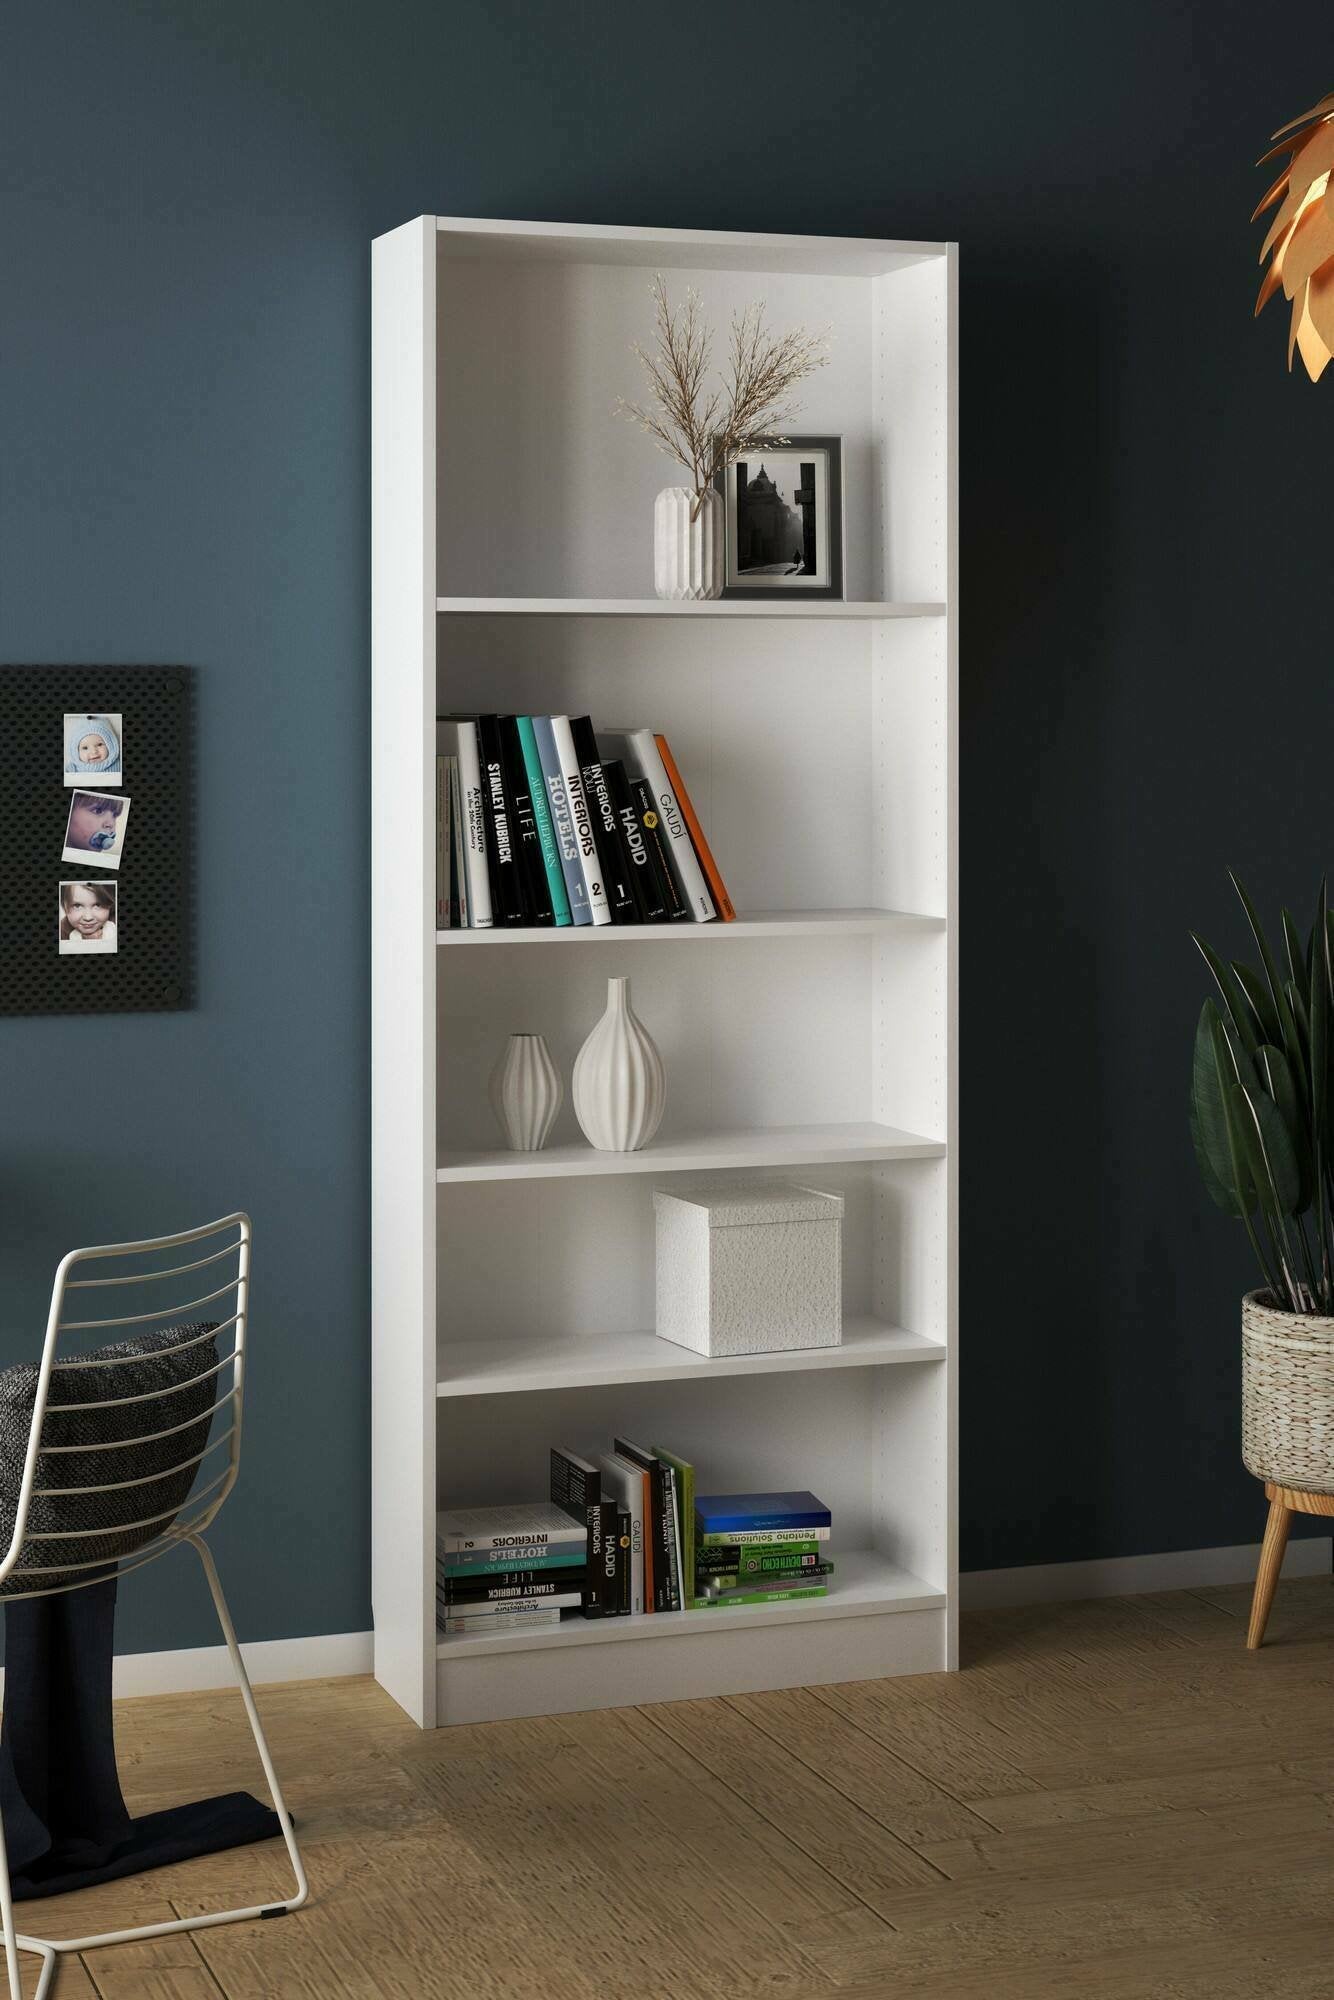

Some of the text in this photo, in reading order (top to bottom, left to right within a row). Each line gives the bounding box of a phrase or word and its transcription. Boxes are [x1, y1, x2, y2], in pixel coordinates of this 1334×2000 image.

[531, 777, 547, 814] AUDREY
[590, 763, 616, 832] INTERIORS
[473, 787, 485, 853] Architecture
[487, 763, 512, 864] STANLEY KUBRICK
[515, 796, 537, 841] LIFE
[548, 776, 577, 861] HOTELS
[568, 775, 595, 857] INTERIORS
[659, 794, 688, 839] GAUDÍ
[620, 807, 647, 865] HADID
[575, 884, 583, 897] 1
[592, 883, 602, 896] 2
[616, 884, 625, 898] 1
[492, 1534, 548, 1547] INTERIORS
[729, 1534, 773, 1543] Solutions
[776, 1532, 816, 1540] Pentaho
[489, 1546, 548, 1561] HOTELS
[605, 1535, 616, 1578] HADID
[762, 1556, 801, 1570] DEATH ECHO
[503, 1571, 533, 1584] LIFE
[488, 1584, 555, 1598] STANLEY KUBRICK
[591, 1592, 596, 1602] 1
[494, 1604, 539, 1612] Architecture
